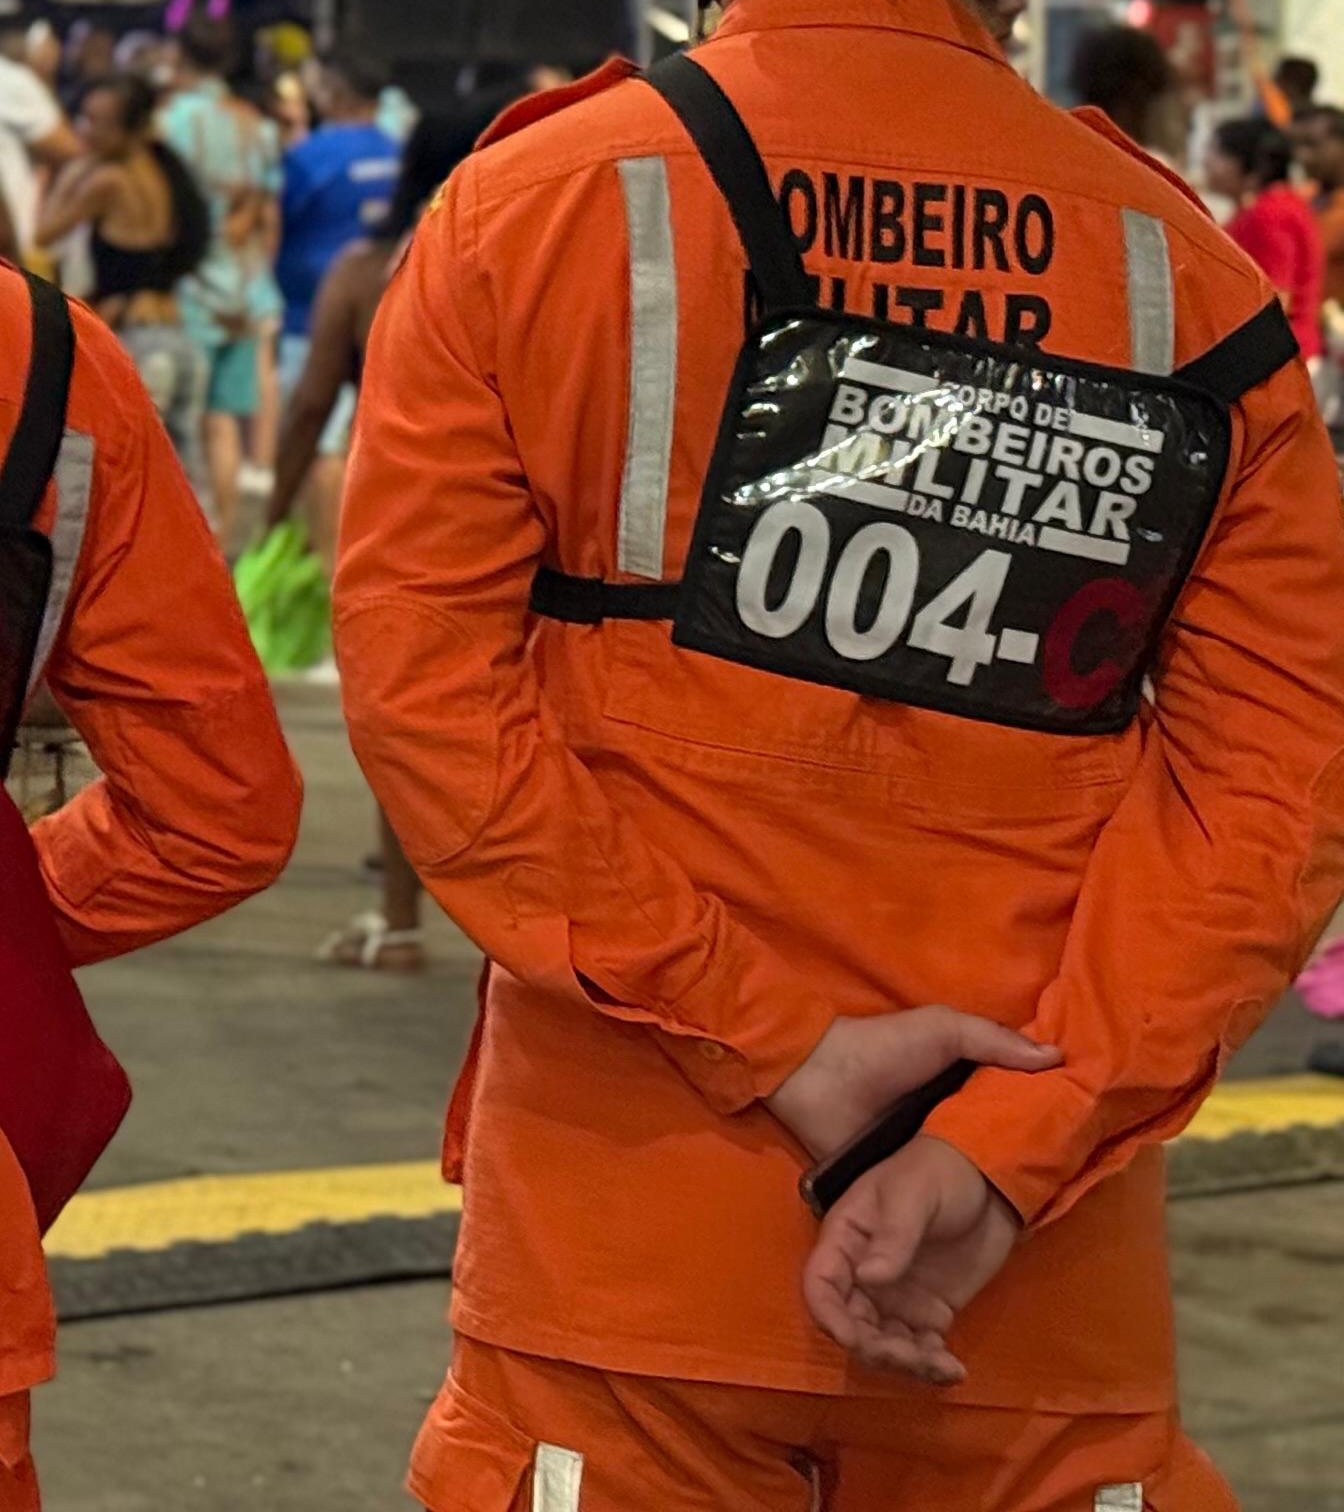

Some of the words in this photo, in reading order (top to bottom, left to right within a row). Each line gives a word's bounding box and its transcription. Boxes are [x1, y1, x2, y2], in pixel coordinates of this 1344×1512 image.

[778, 168, 1055, 276] OMBEIRO
[828, 383, 1155, 495] BOMBEIROS
[1034, 402, 1070, 431] DE
[819, 423, 1138, 541] MILITAR
[906, 493, 944, 522] DA
[949, 504, 1037, 547] BAHIA
[735, 499, 1148, 709] 004-C
